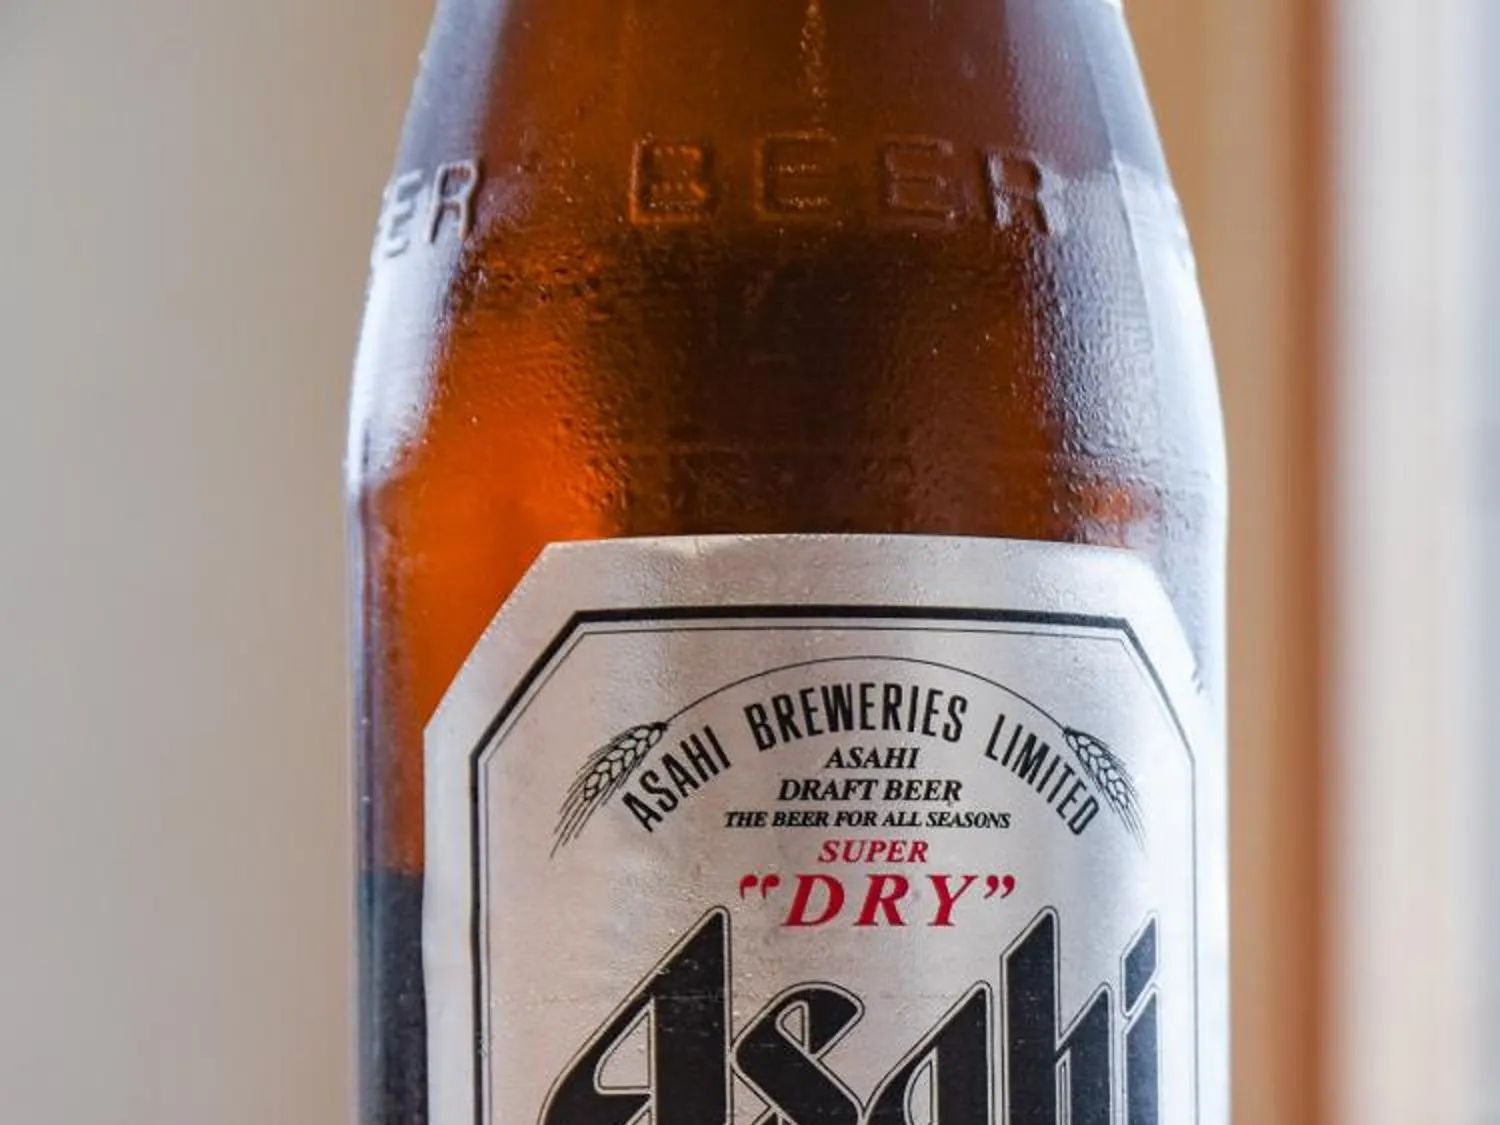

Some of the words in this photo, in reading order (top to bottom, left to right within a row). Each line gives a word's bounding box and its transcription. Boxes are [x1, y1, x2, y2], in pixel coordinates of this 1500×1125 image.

[629, 132, 1052, 236] BEER
[620, 725, 732, 834] ASAHI
[744, 681, 968, 753] BREWERIES
[985, 712, 1103, 837] LIMITED
[823, 746, 921, 770] ASAHI
[776, 778, 878, 802] DRAFT
[882, 778, 963, 803] BEER
[723, 810, 769, 829] THE
[771, 810, 829, 829] BEER
[832, 810, 879, 828] FOR
[881, 811, 923, 828] ALL
[925, 811, 1011, 830] SEASONS
[817, 839, 929, 864] SUPER
